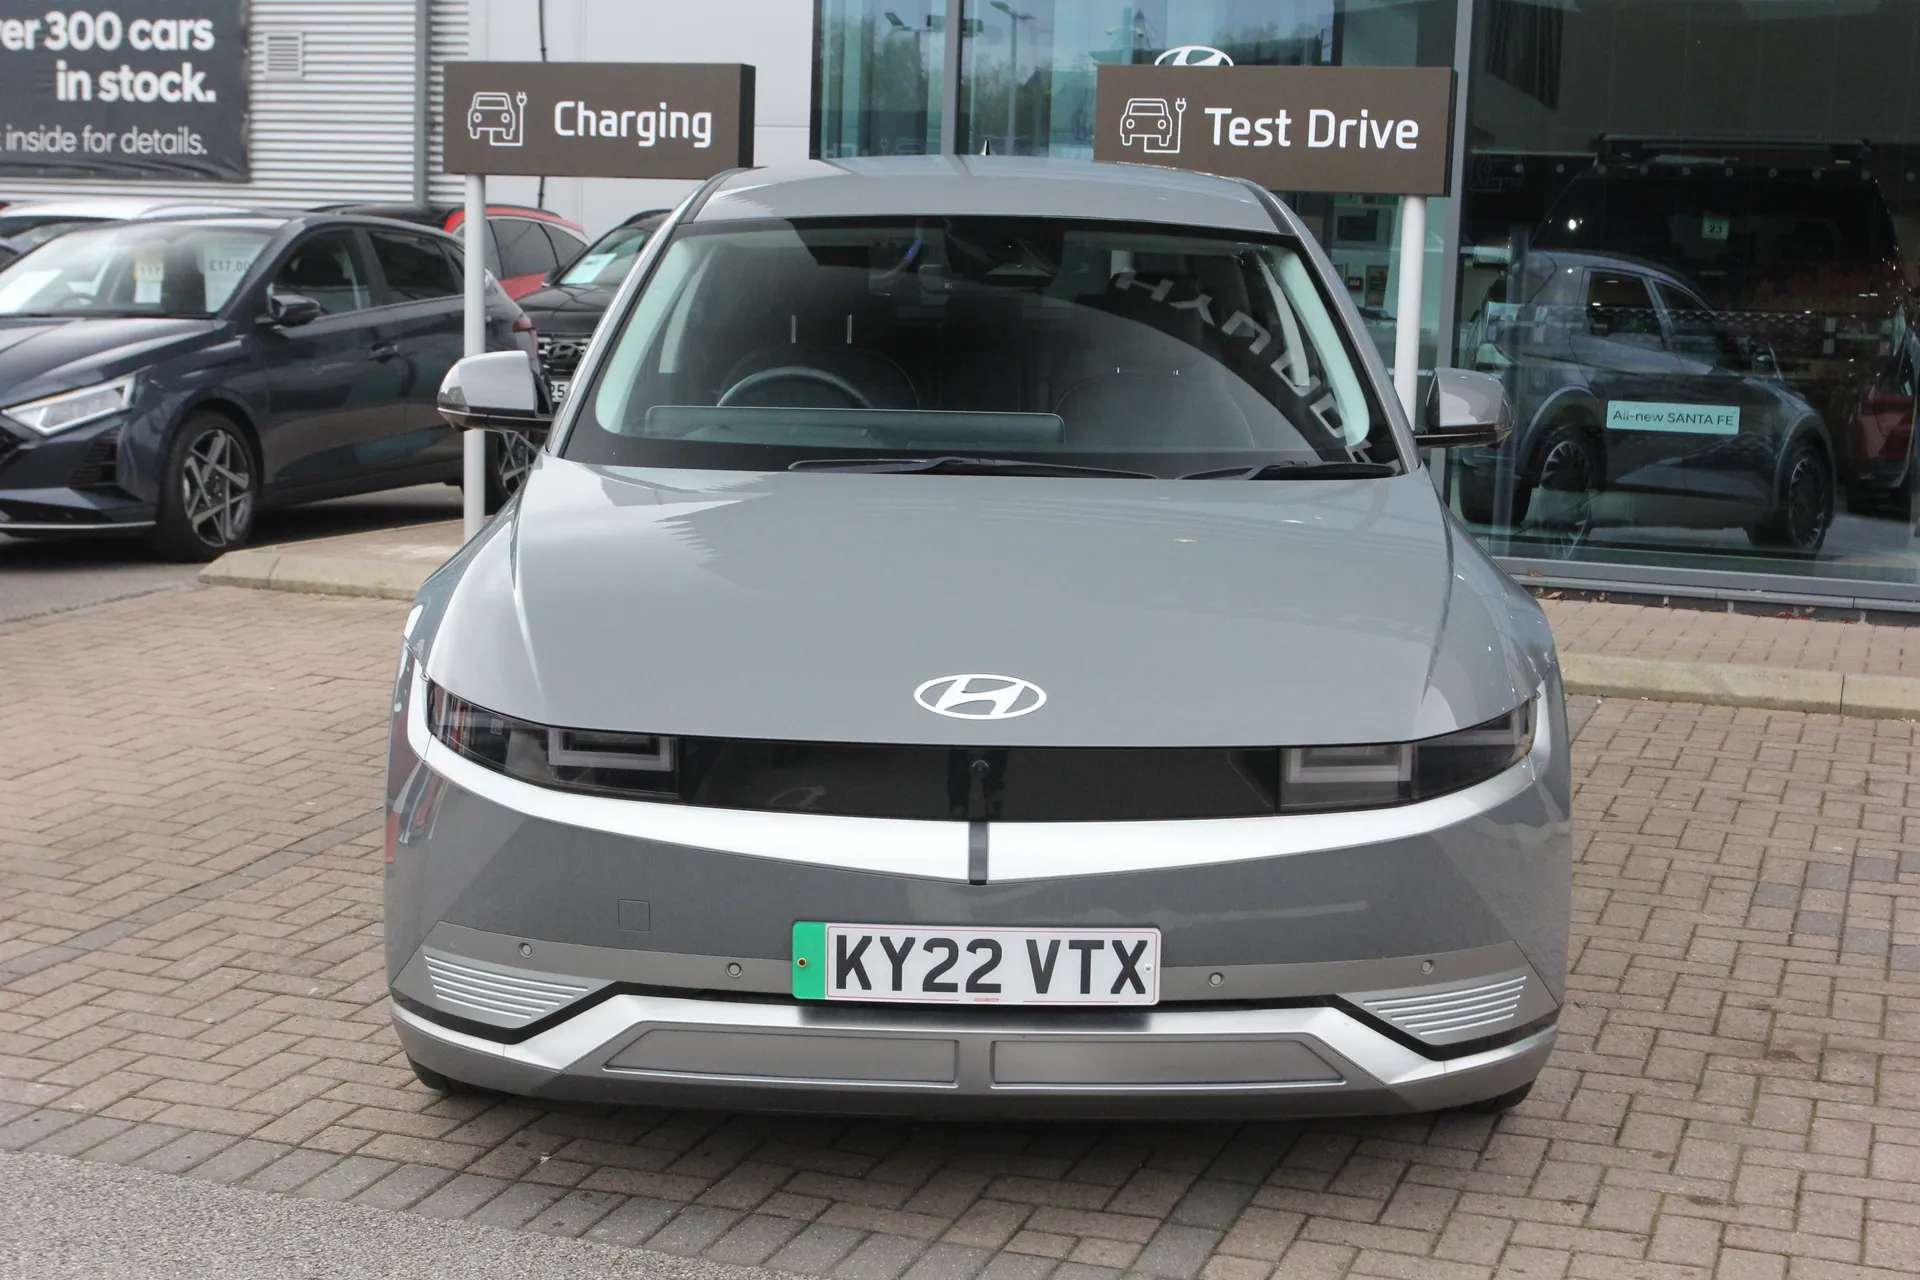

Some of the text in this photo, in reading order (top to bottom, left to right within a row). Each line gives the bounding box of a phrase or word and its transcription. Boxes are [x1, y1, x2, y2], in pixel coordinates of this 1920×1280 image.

[0, 10, 216, 51] er 300 cars
[56, 59, 217, 102] in stock.
[6, 123, 208, 155] inside for details.
[554, 100, 712, 148] Charging
[1204, 107, 1419, 149] Test Drive
[1667, 412, 1714, 425] SANTA
[1717, 415, 1734, 426] FE
[835, 934, 1149, 995] KY22 VTX
